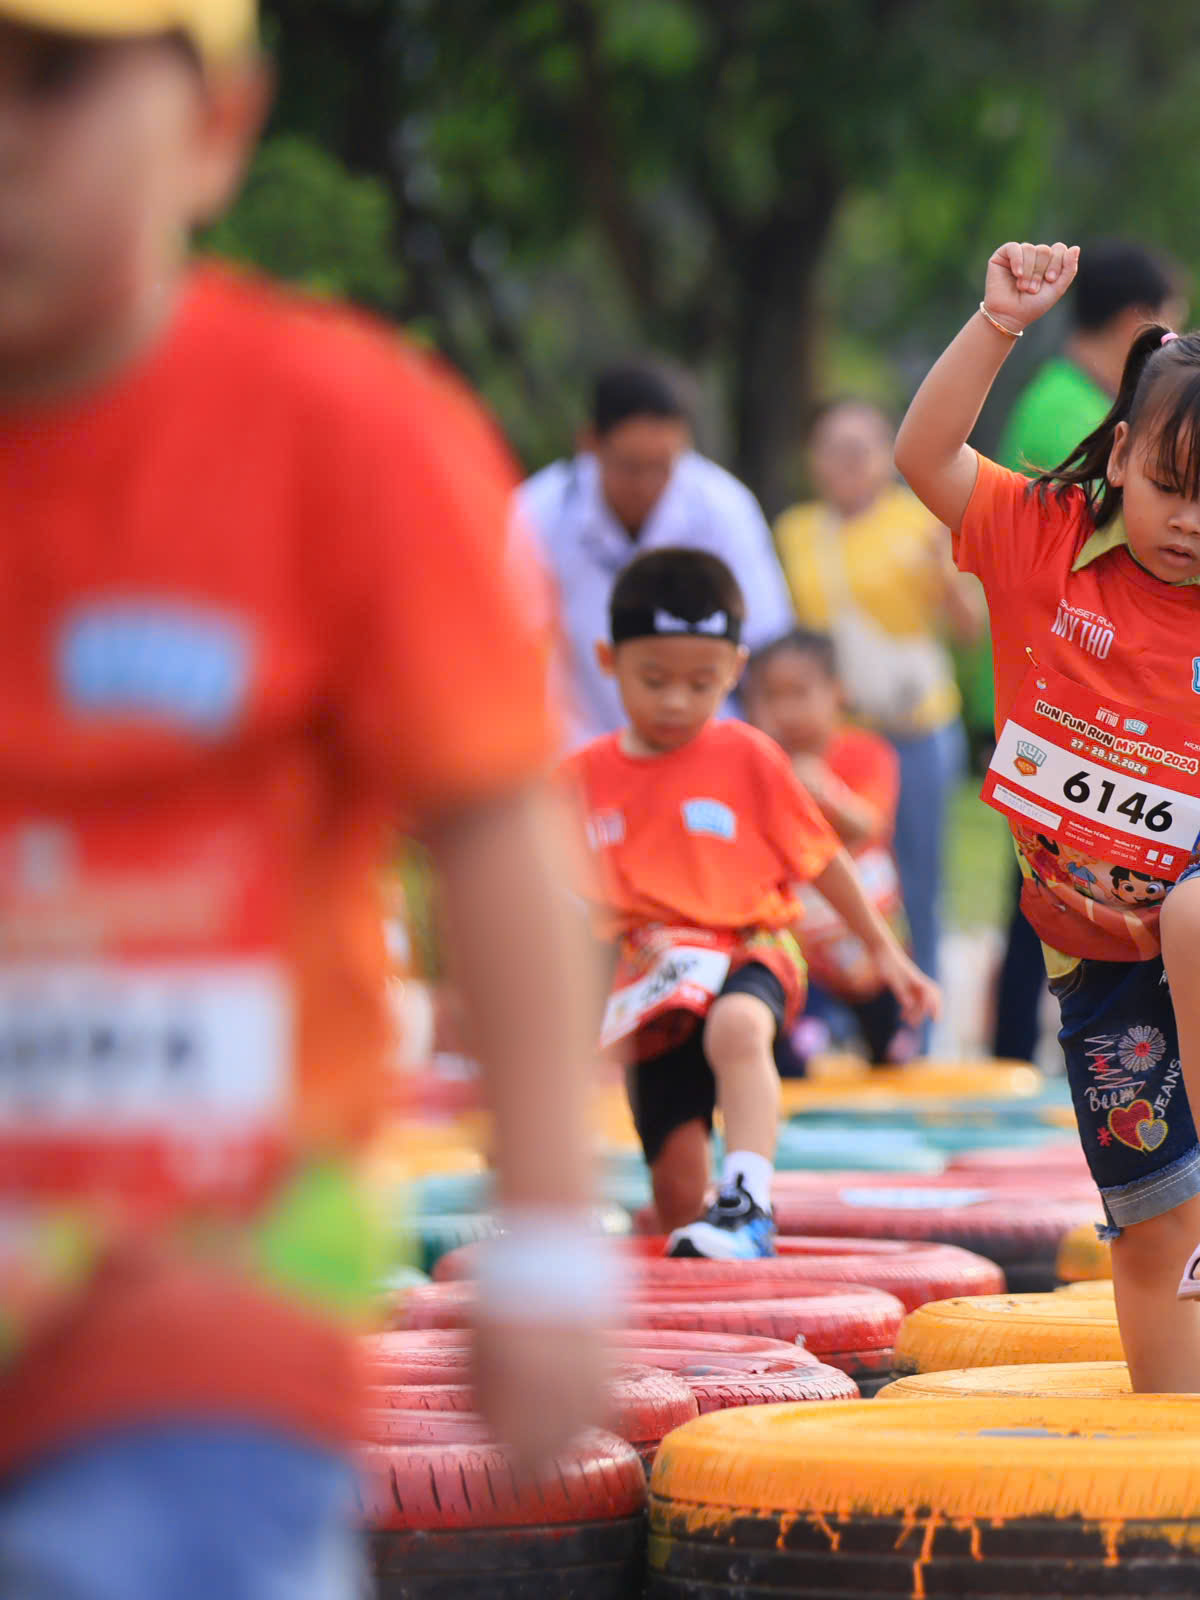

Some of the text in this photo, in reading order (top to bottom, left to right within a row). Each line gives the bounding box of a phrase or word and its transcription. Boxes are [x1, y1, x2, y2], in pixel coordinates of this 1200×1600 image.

[1051, 607, 1115, 660] MY THO
[1060, 599, 1116, 631] SUNSET RUN
[1035, 700, 1061, 721] KUN
[1061, 713, 1087, 733] FUN
[1087, 724, 1115, 747] RUN
[1137, 741, 1164, 762] THO
[1162, 751, 1199, 775] 2024
[1071, 738, 1083, 749] 27
[1091, 746, 1149, 775] 28.12.2024
[1063, 771, 1173, 832] 6146
[1153, 1058, 1181, 1118] JEANS
